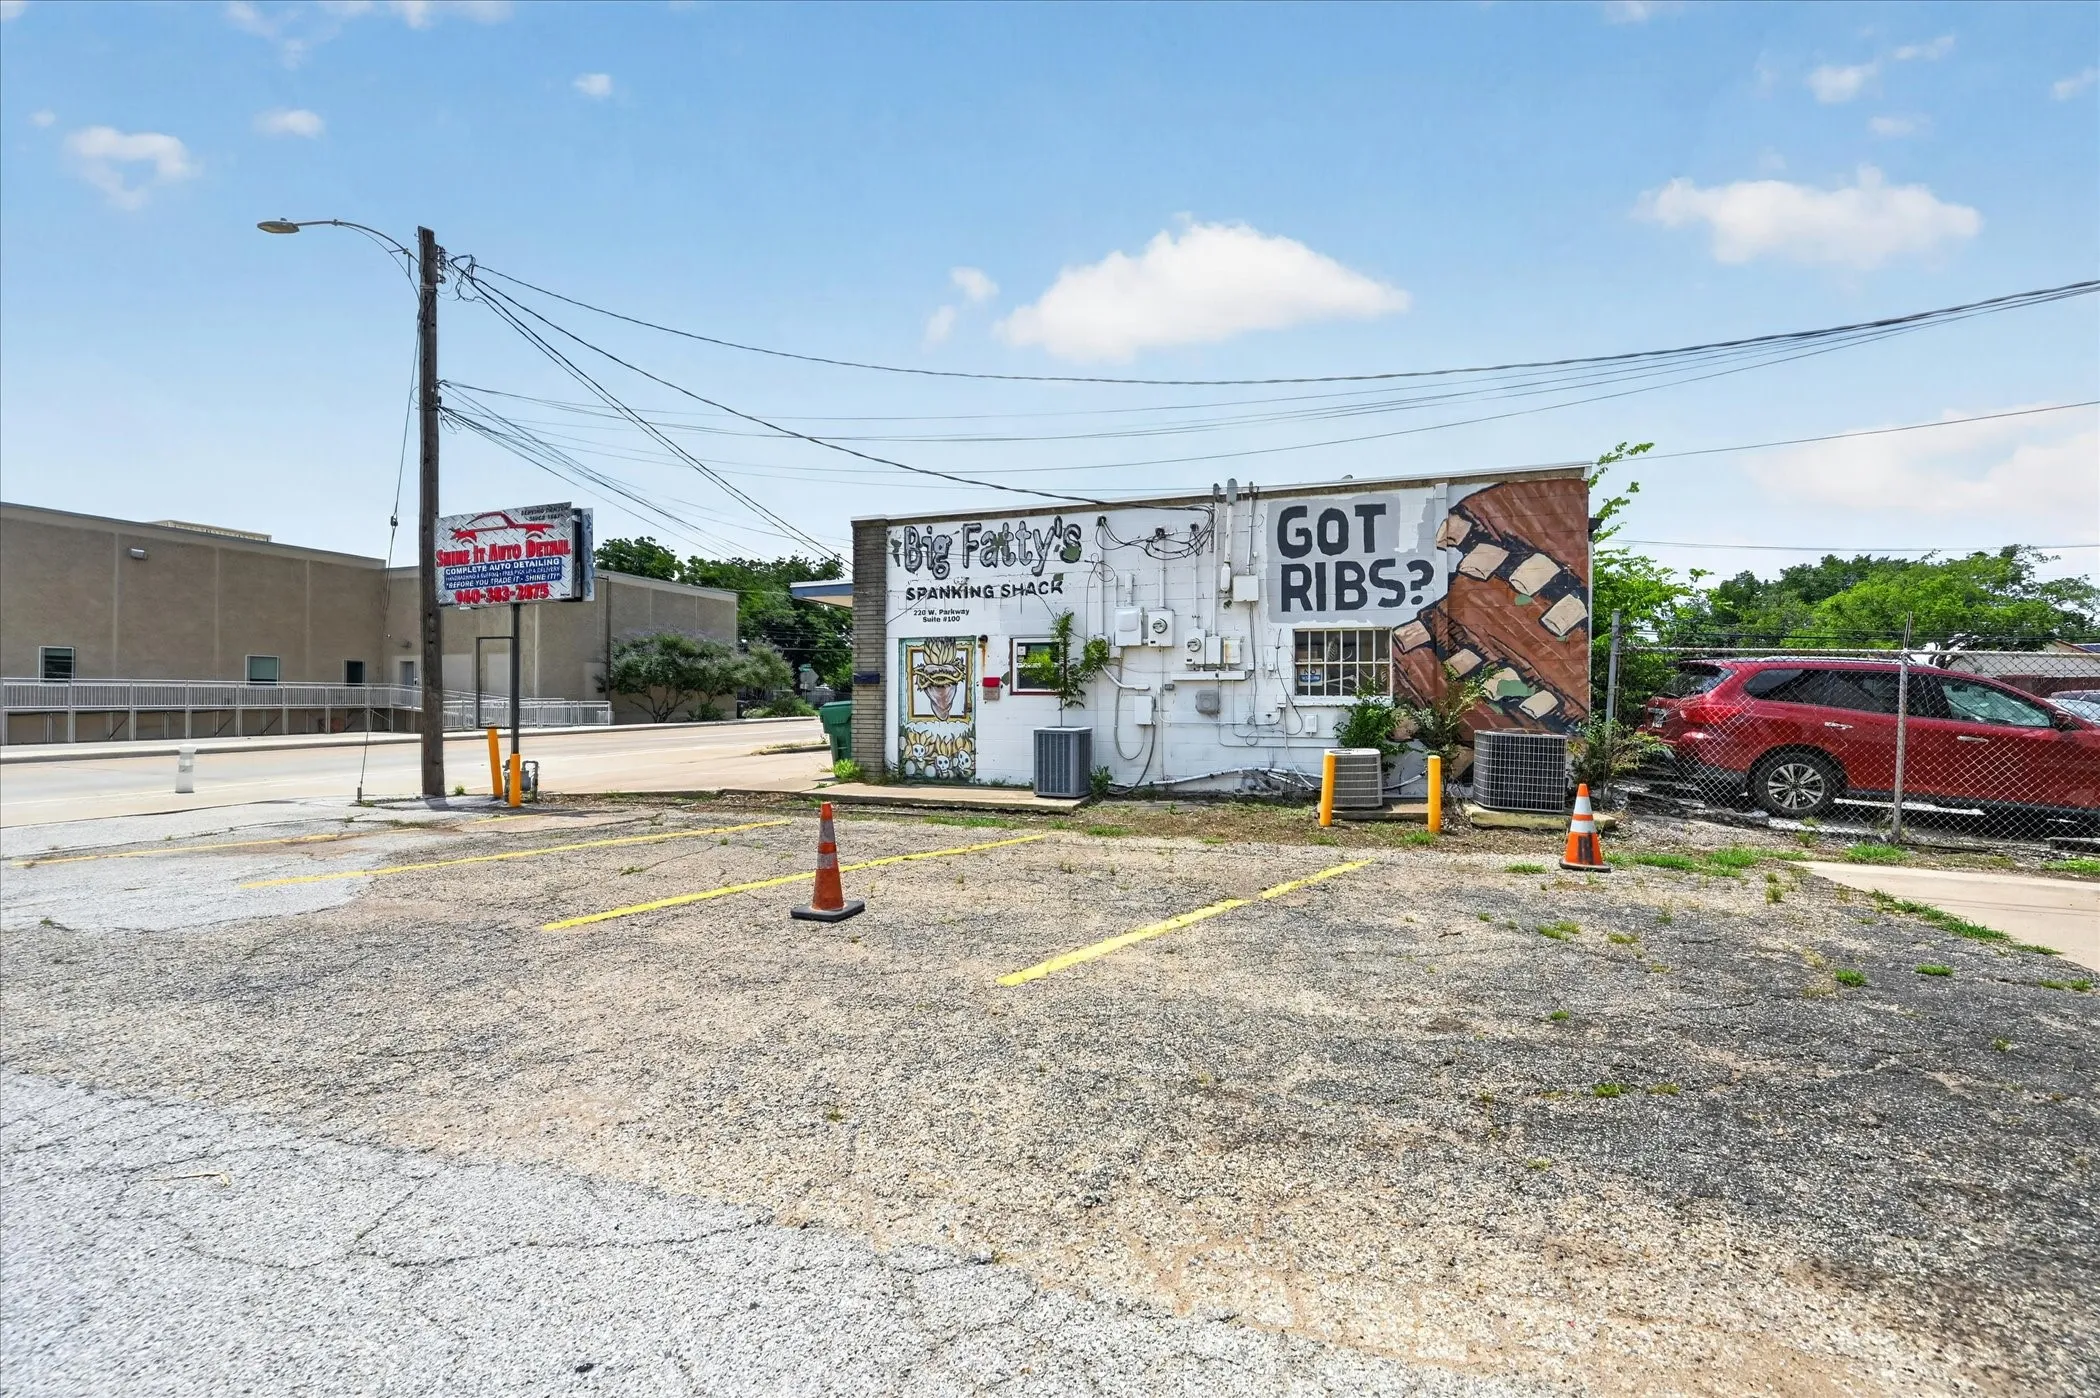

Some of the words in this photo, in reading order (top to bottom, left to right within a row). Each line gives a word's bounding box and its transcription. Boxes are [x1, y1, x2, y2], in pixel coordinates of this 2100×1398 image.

[1277, 502, 1387, 559] GOT
[435, 549, 470, 567] SHINE
[473, 545, 486, 562] IT
[489, 543, 522, 562] AUTO
[525, 539, 571, 558] DETAIL
[903, 524, 953, 580] Big
[961, 515, 1083, 577] Fatty's
[445, 564, 487, 576] COMPLETE
[489, 561, 511, 571] AUTO
[513, 557, 560, 569] DETAILING
[476, 578, 489, 586] YOU
[490, 576, 512, 585] TRADE
[525, 573, 546, 582] SHINE
[1280, 558, 1435, 613] RIBS?
[905, 584, 995, 601] SPANKING
[1000, 580, 1064, 598] SHACK
[913, 608, 927, 616] 220
[928, 608, 938, 616] W.
[938, 608, 970, 617] Parkway
[943, 615, 961, 623] #100
